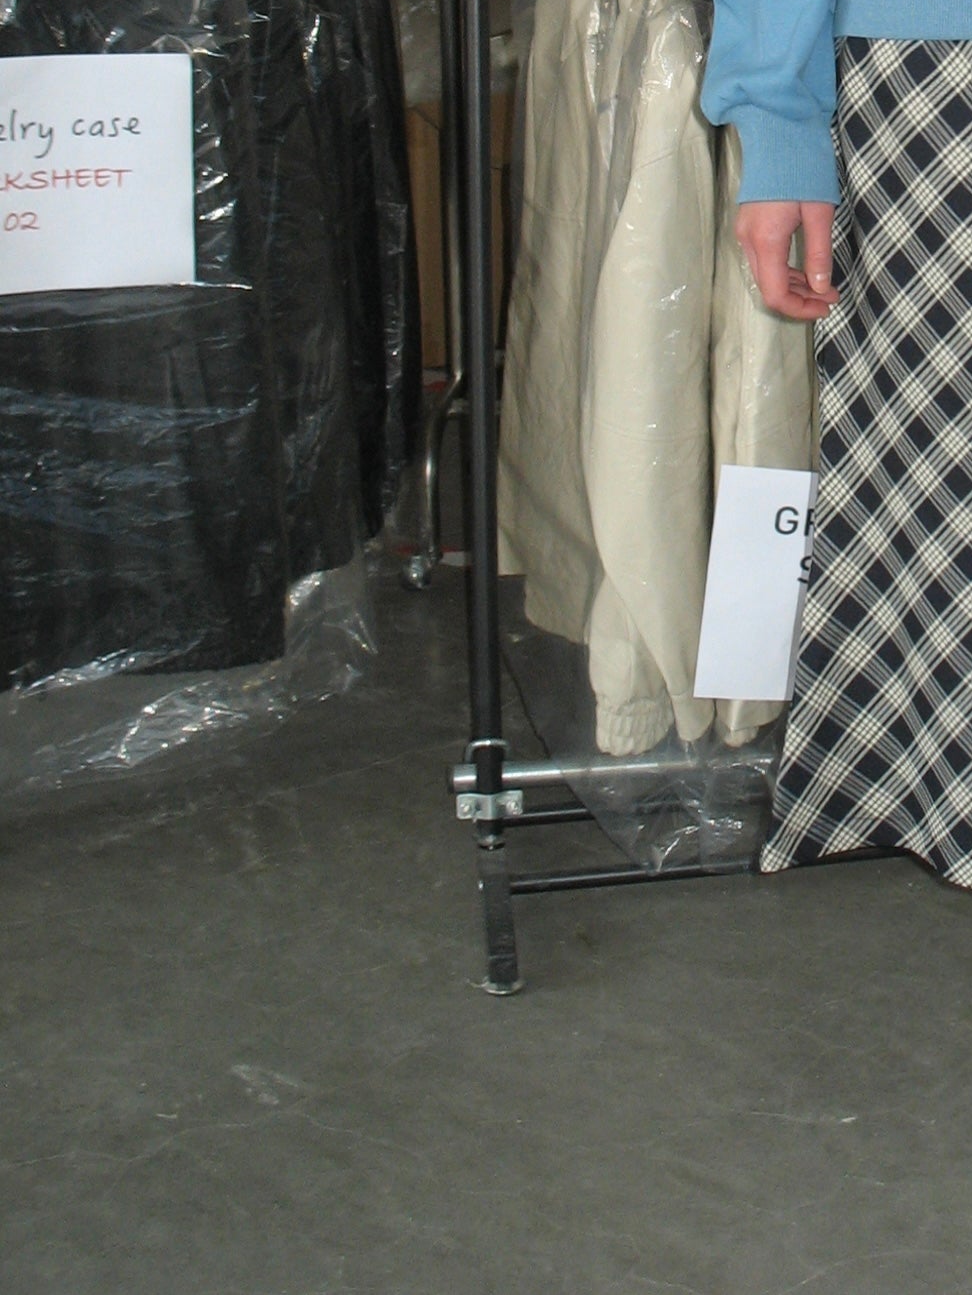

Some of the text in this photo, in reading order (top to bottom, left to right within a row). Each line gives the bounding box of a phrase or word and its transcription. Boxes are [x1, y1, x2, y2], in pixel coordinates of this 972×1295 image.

[72, 116, 141, 138] case
[0, 169, 132, 191] KSHEET
[3, 211, 40, 232] 02
